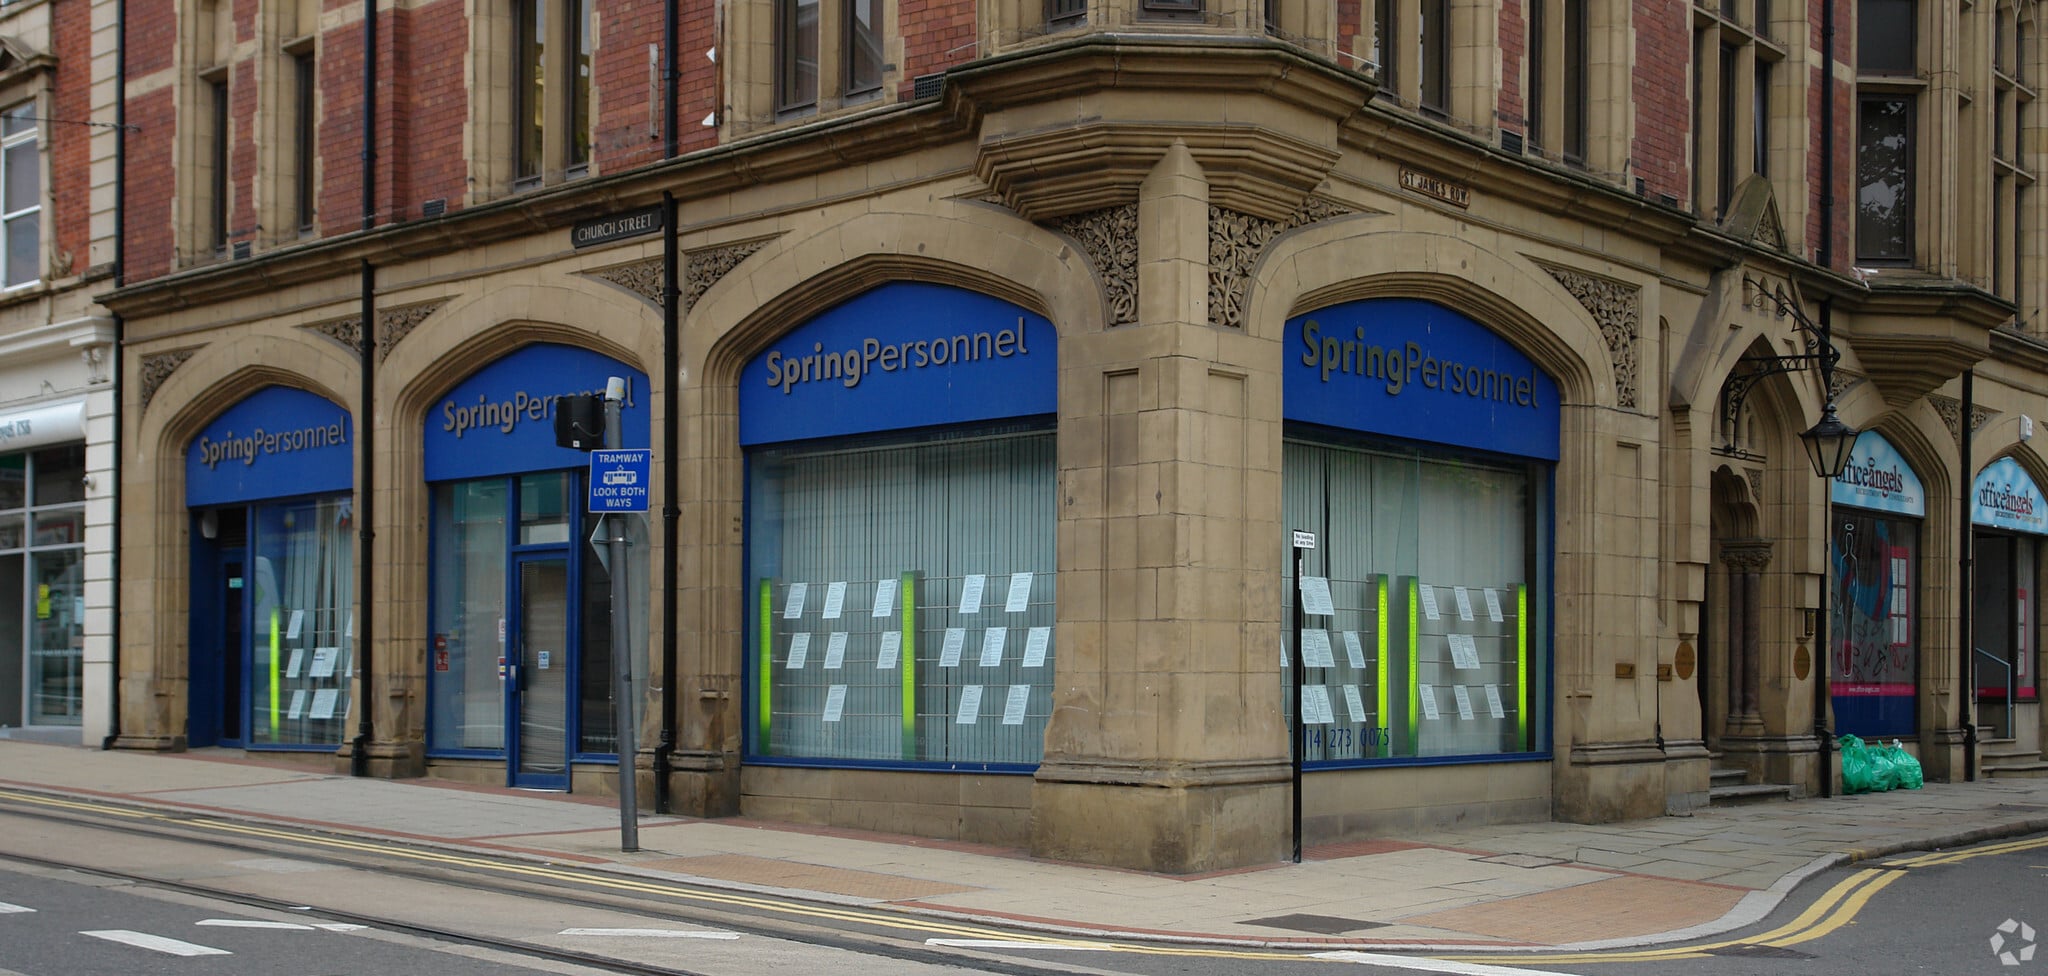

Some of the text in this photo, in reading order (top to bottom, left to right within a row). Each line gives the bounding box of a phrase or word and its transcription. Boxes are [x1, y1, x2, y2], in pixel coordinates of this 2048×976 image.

[1418, 177, 1446, 197] JAMES
[1450, 186, 1467, 203] ROW
[578, 213, 652, 241] CHURCH STREET
[599, 453, 643, 463] TRAMWAY
[593, 487, 645, 497] LOOK BOTH
[606, 498, 632, 508] WAYS
[1330, 728, 1352, 748] 273
[1360, 727, 1389, 746] 0075
